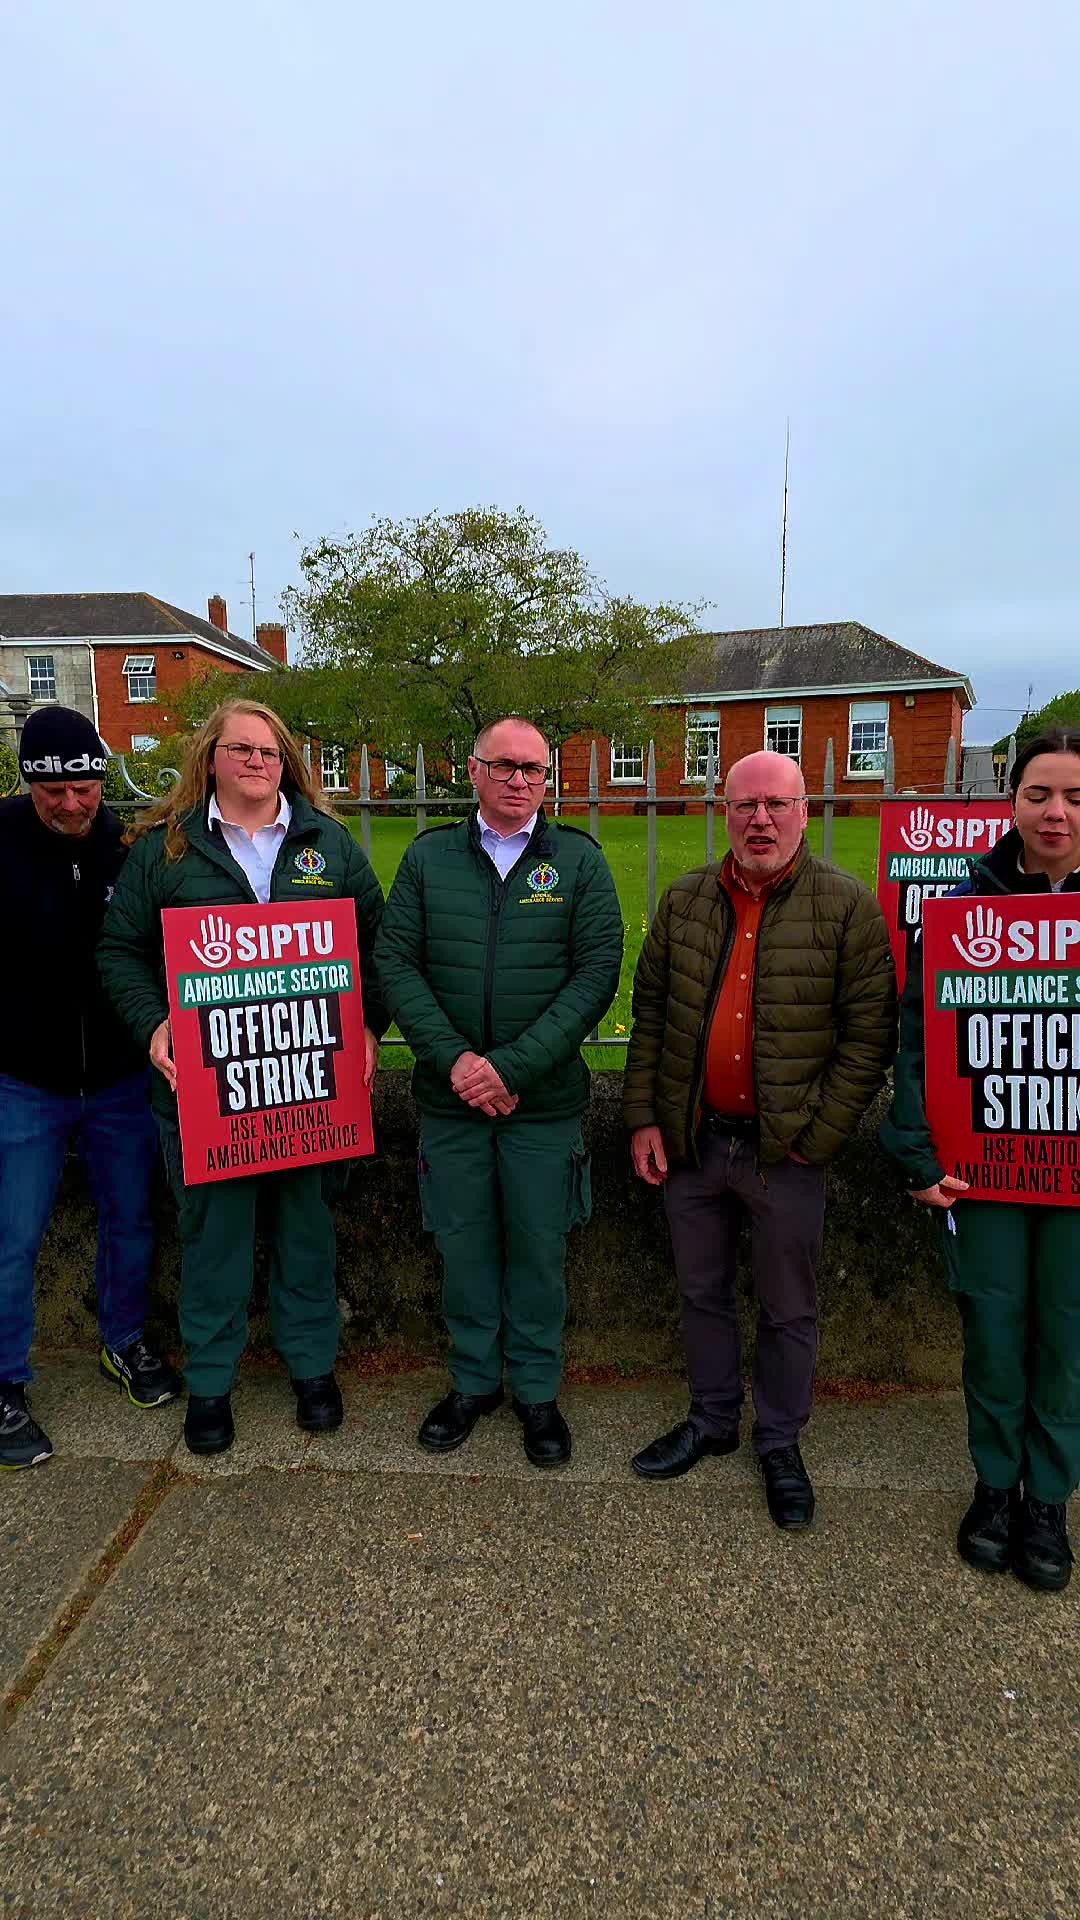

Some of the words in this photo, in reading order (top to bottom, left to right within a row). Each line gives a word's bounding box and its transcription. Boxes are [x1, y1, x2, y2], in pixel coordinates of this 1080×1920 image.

[23, 754, 107, 773] adidas
[936, 818, 1010, 848] SIPT
[889, 857, 972, 877] AMBULANC
[235, 920, 334, 962] SIPTU
[1007, 920, 1080, 962] SIP
[184, 970, 287, 1003] AMBULANCE
[290, 964, 349, 992] SECTOR
[940, 975, 1069, 1004] AMBULANCE
[208, 998, 336, 1059] OFFICIAL
[968, 1013, 1080, 1070] OFFICI
[226, 1050, 329, 1111] STRIKE
[983, 1074, 1080, 1131] STRIK
[230, 1115, 259, 1142] HSE
[262, 1103, 334, 1137] NATIONAL
[206, 1133, 297, 1172] AMBULANCE
[301, 1123, 360, 1155] SERVICE
[983, 1137, 1017, 1163] HSE
[1024, 1139, 1079, 1167] NATIO
[953, 1161, 1064, 1194] AMBULANCE
